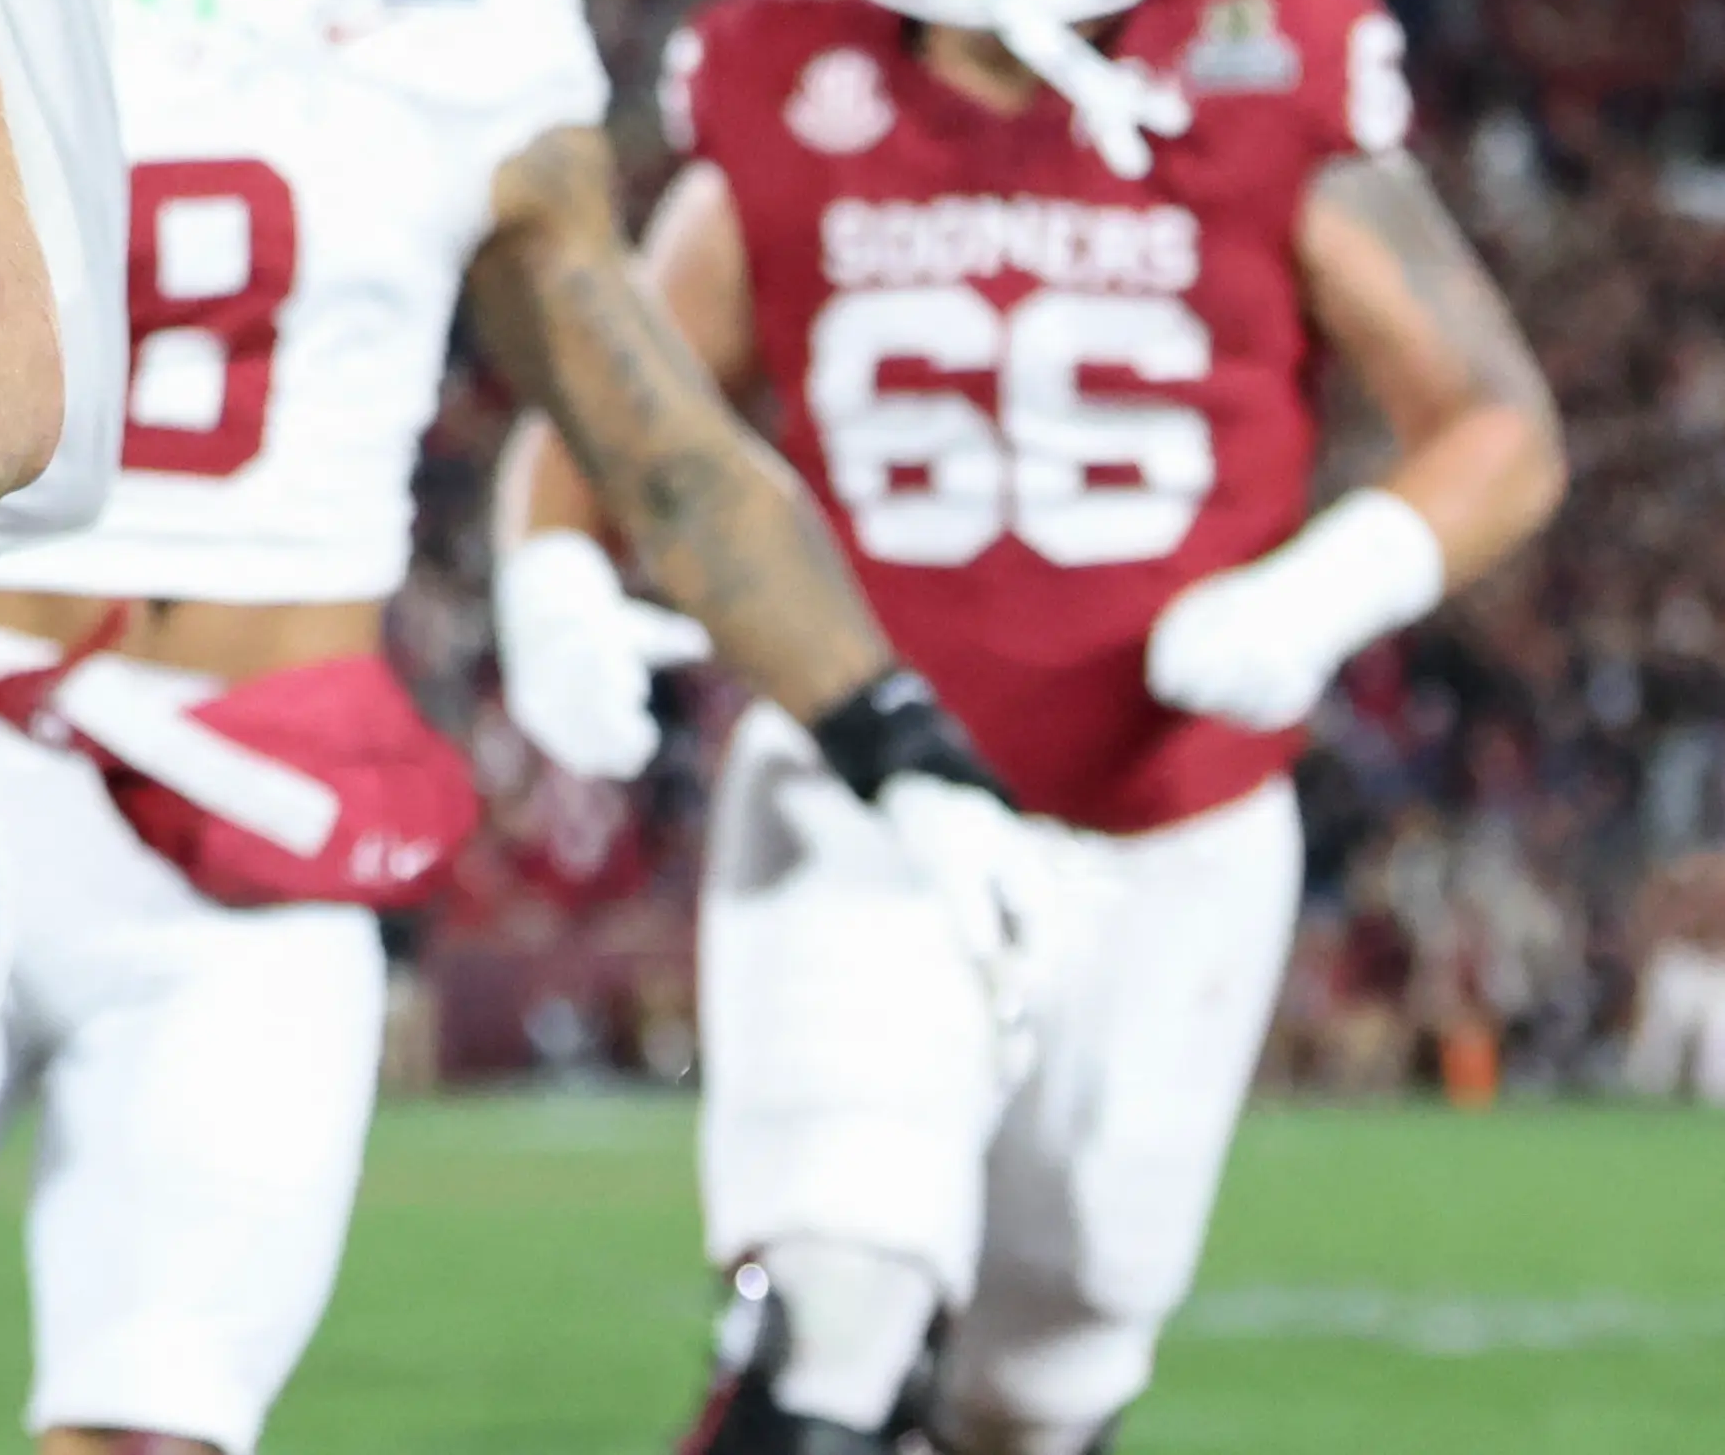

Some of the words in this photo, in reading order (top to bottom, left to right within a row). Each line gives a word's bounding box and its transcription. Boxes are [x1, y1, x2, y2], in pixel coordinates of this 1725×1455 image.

[120, 157, 298, 477] 8
[820, 192, 1202, 293] SOONERS
[807, 286, 1217, 568] 66
